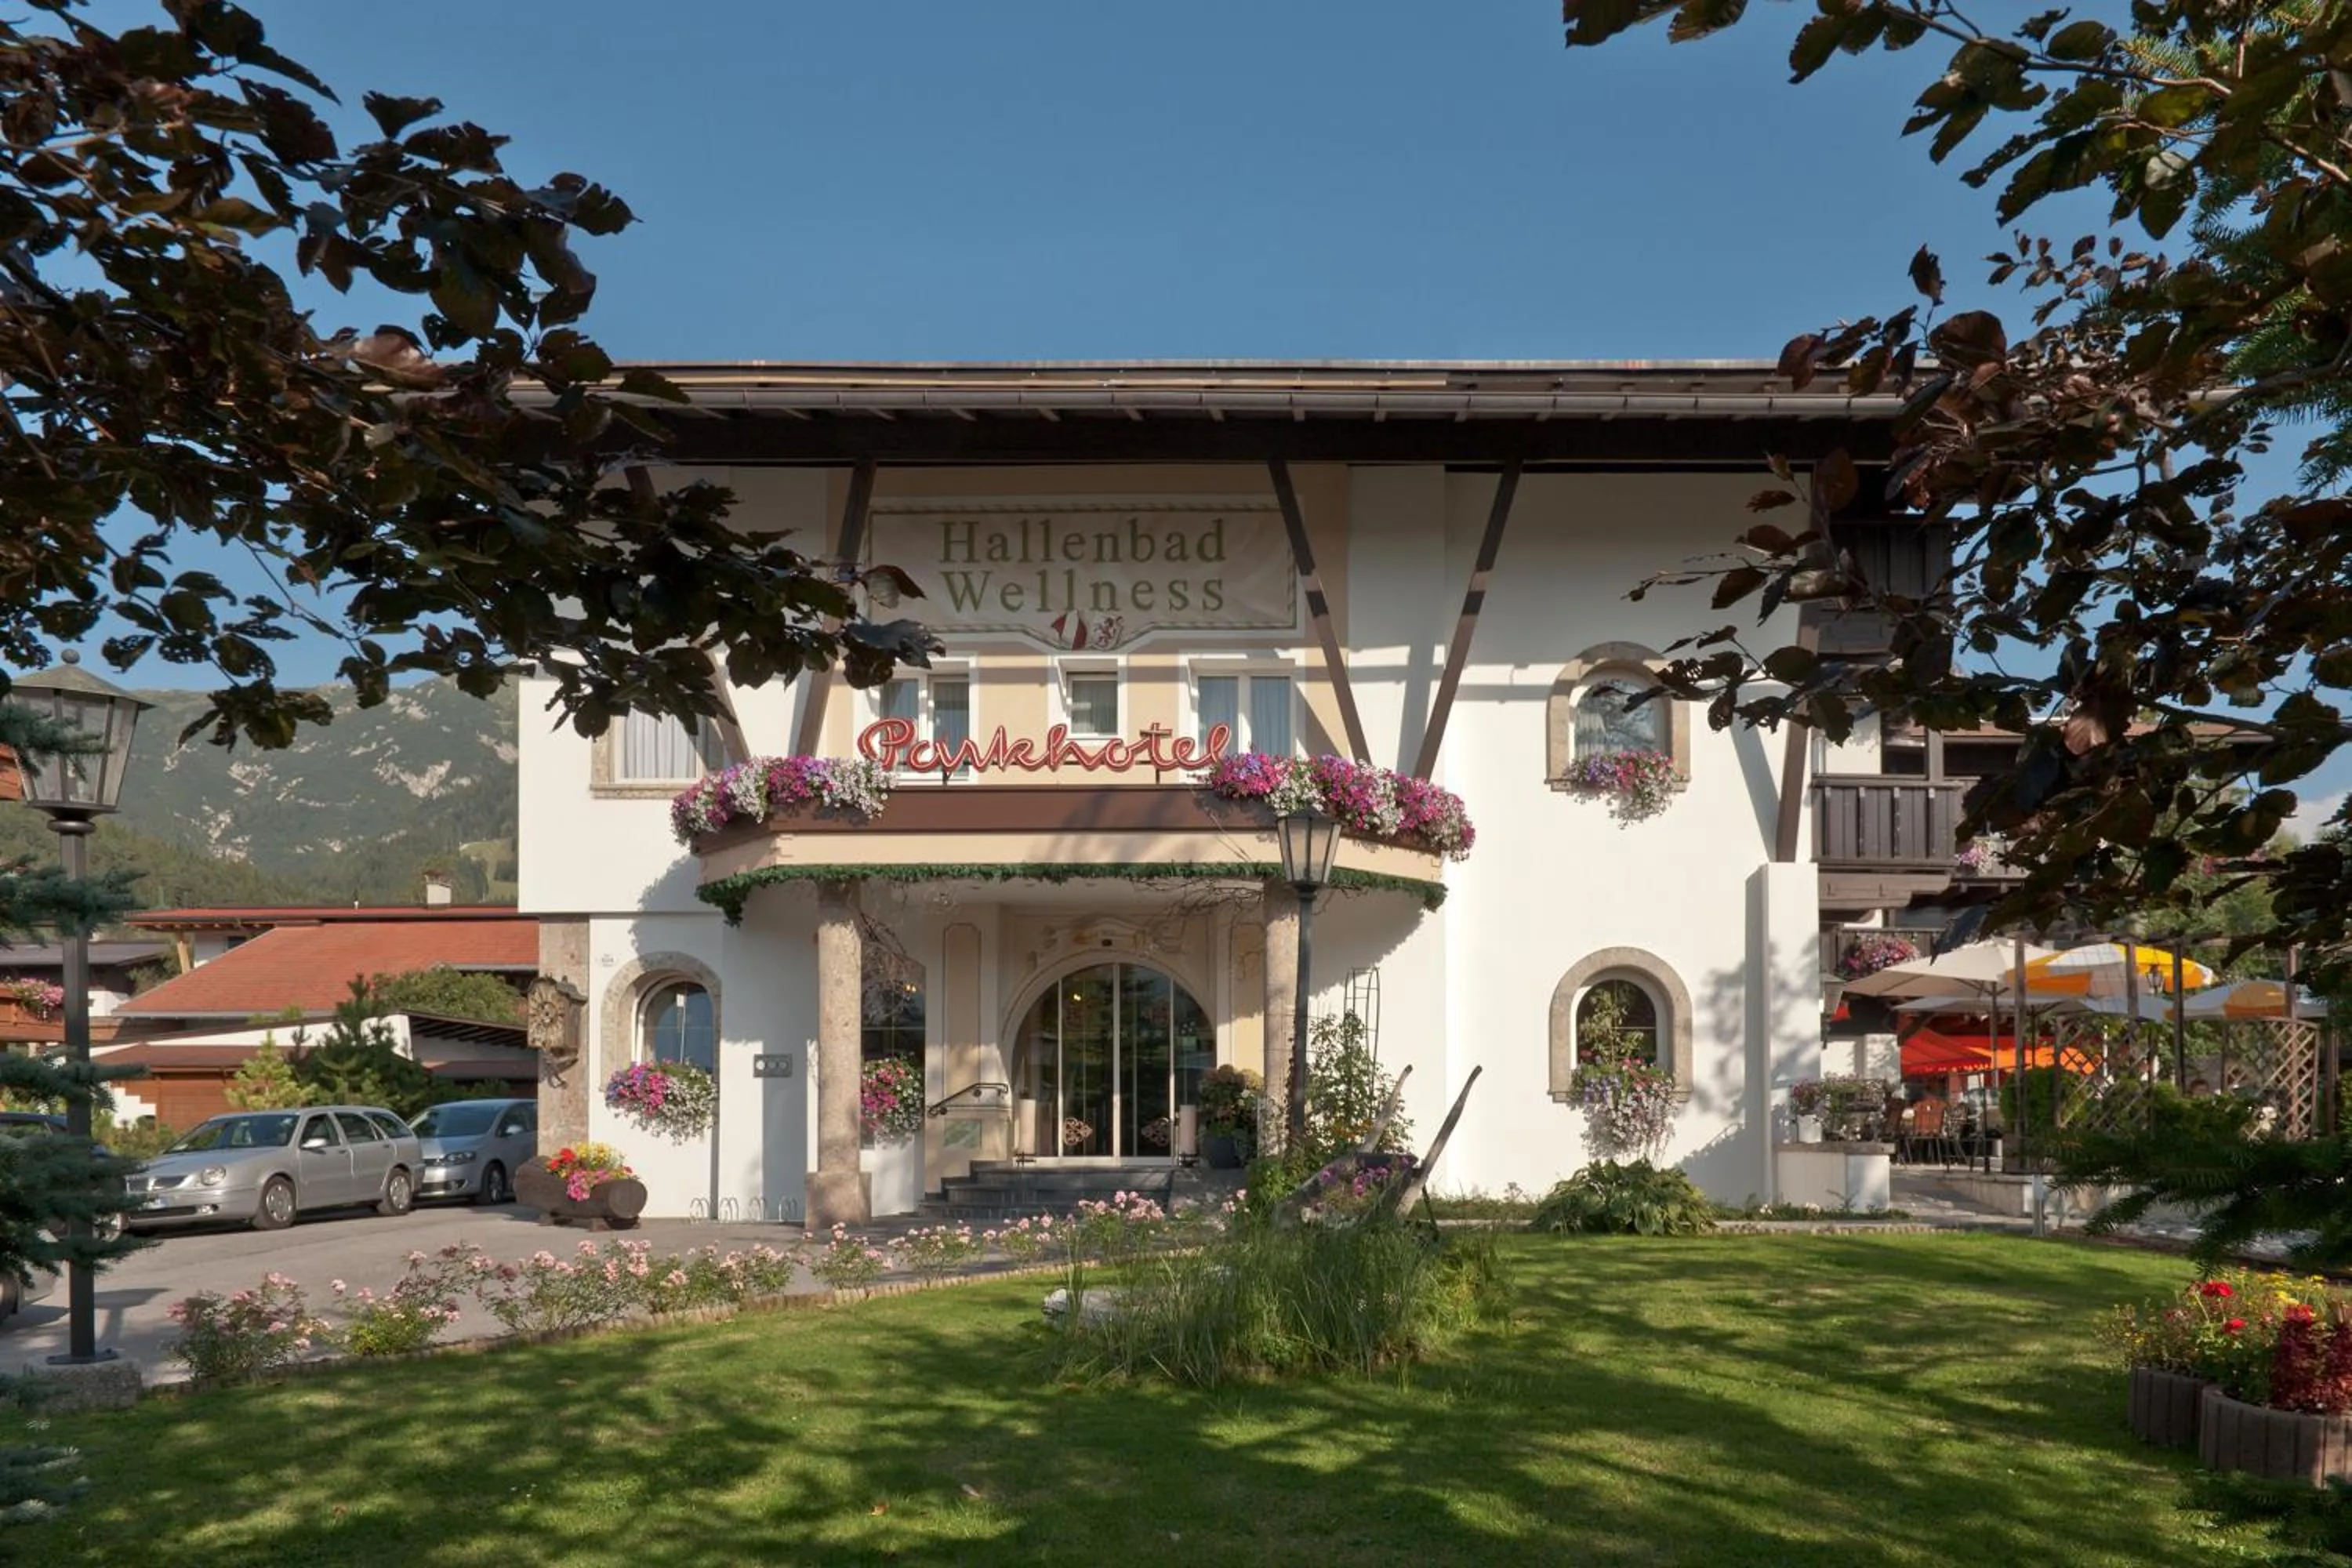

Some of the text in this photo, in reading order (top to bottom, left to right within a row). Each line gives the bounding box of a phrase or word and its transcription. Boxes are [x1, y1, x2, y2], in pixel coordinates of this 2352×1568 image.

[942, 519, 1227, 563] Hallenbad
[942, 568, 1224, 613] Wellness
[857, 717, 1232, 772] Parkhotel
